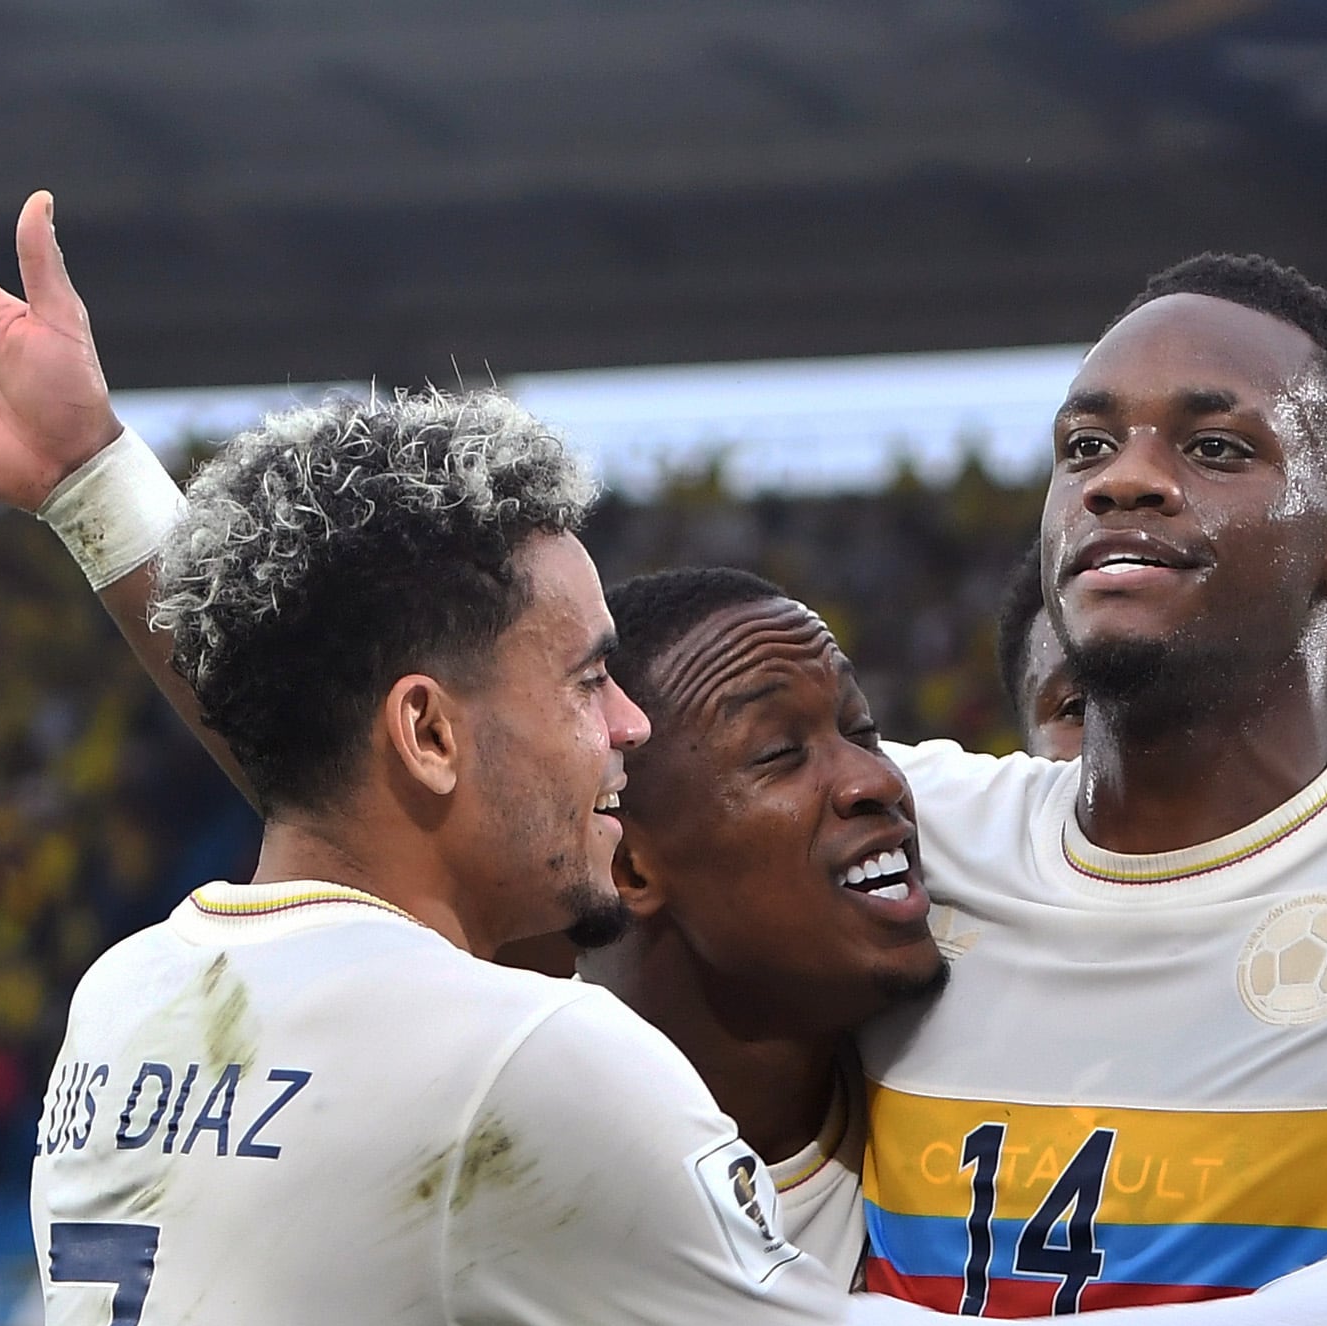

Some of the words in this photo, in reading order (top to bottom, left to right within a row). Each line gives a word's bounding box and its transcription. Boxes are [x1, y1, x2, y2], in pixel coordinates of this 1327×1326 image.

[116, 1062, 313, 1161] DIAZ
[920, 1140, 1223, 1202] CTAULT
[958, 1121, 1118, 1318] 14
